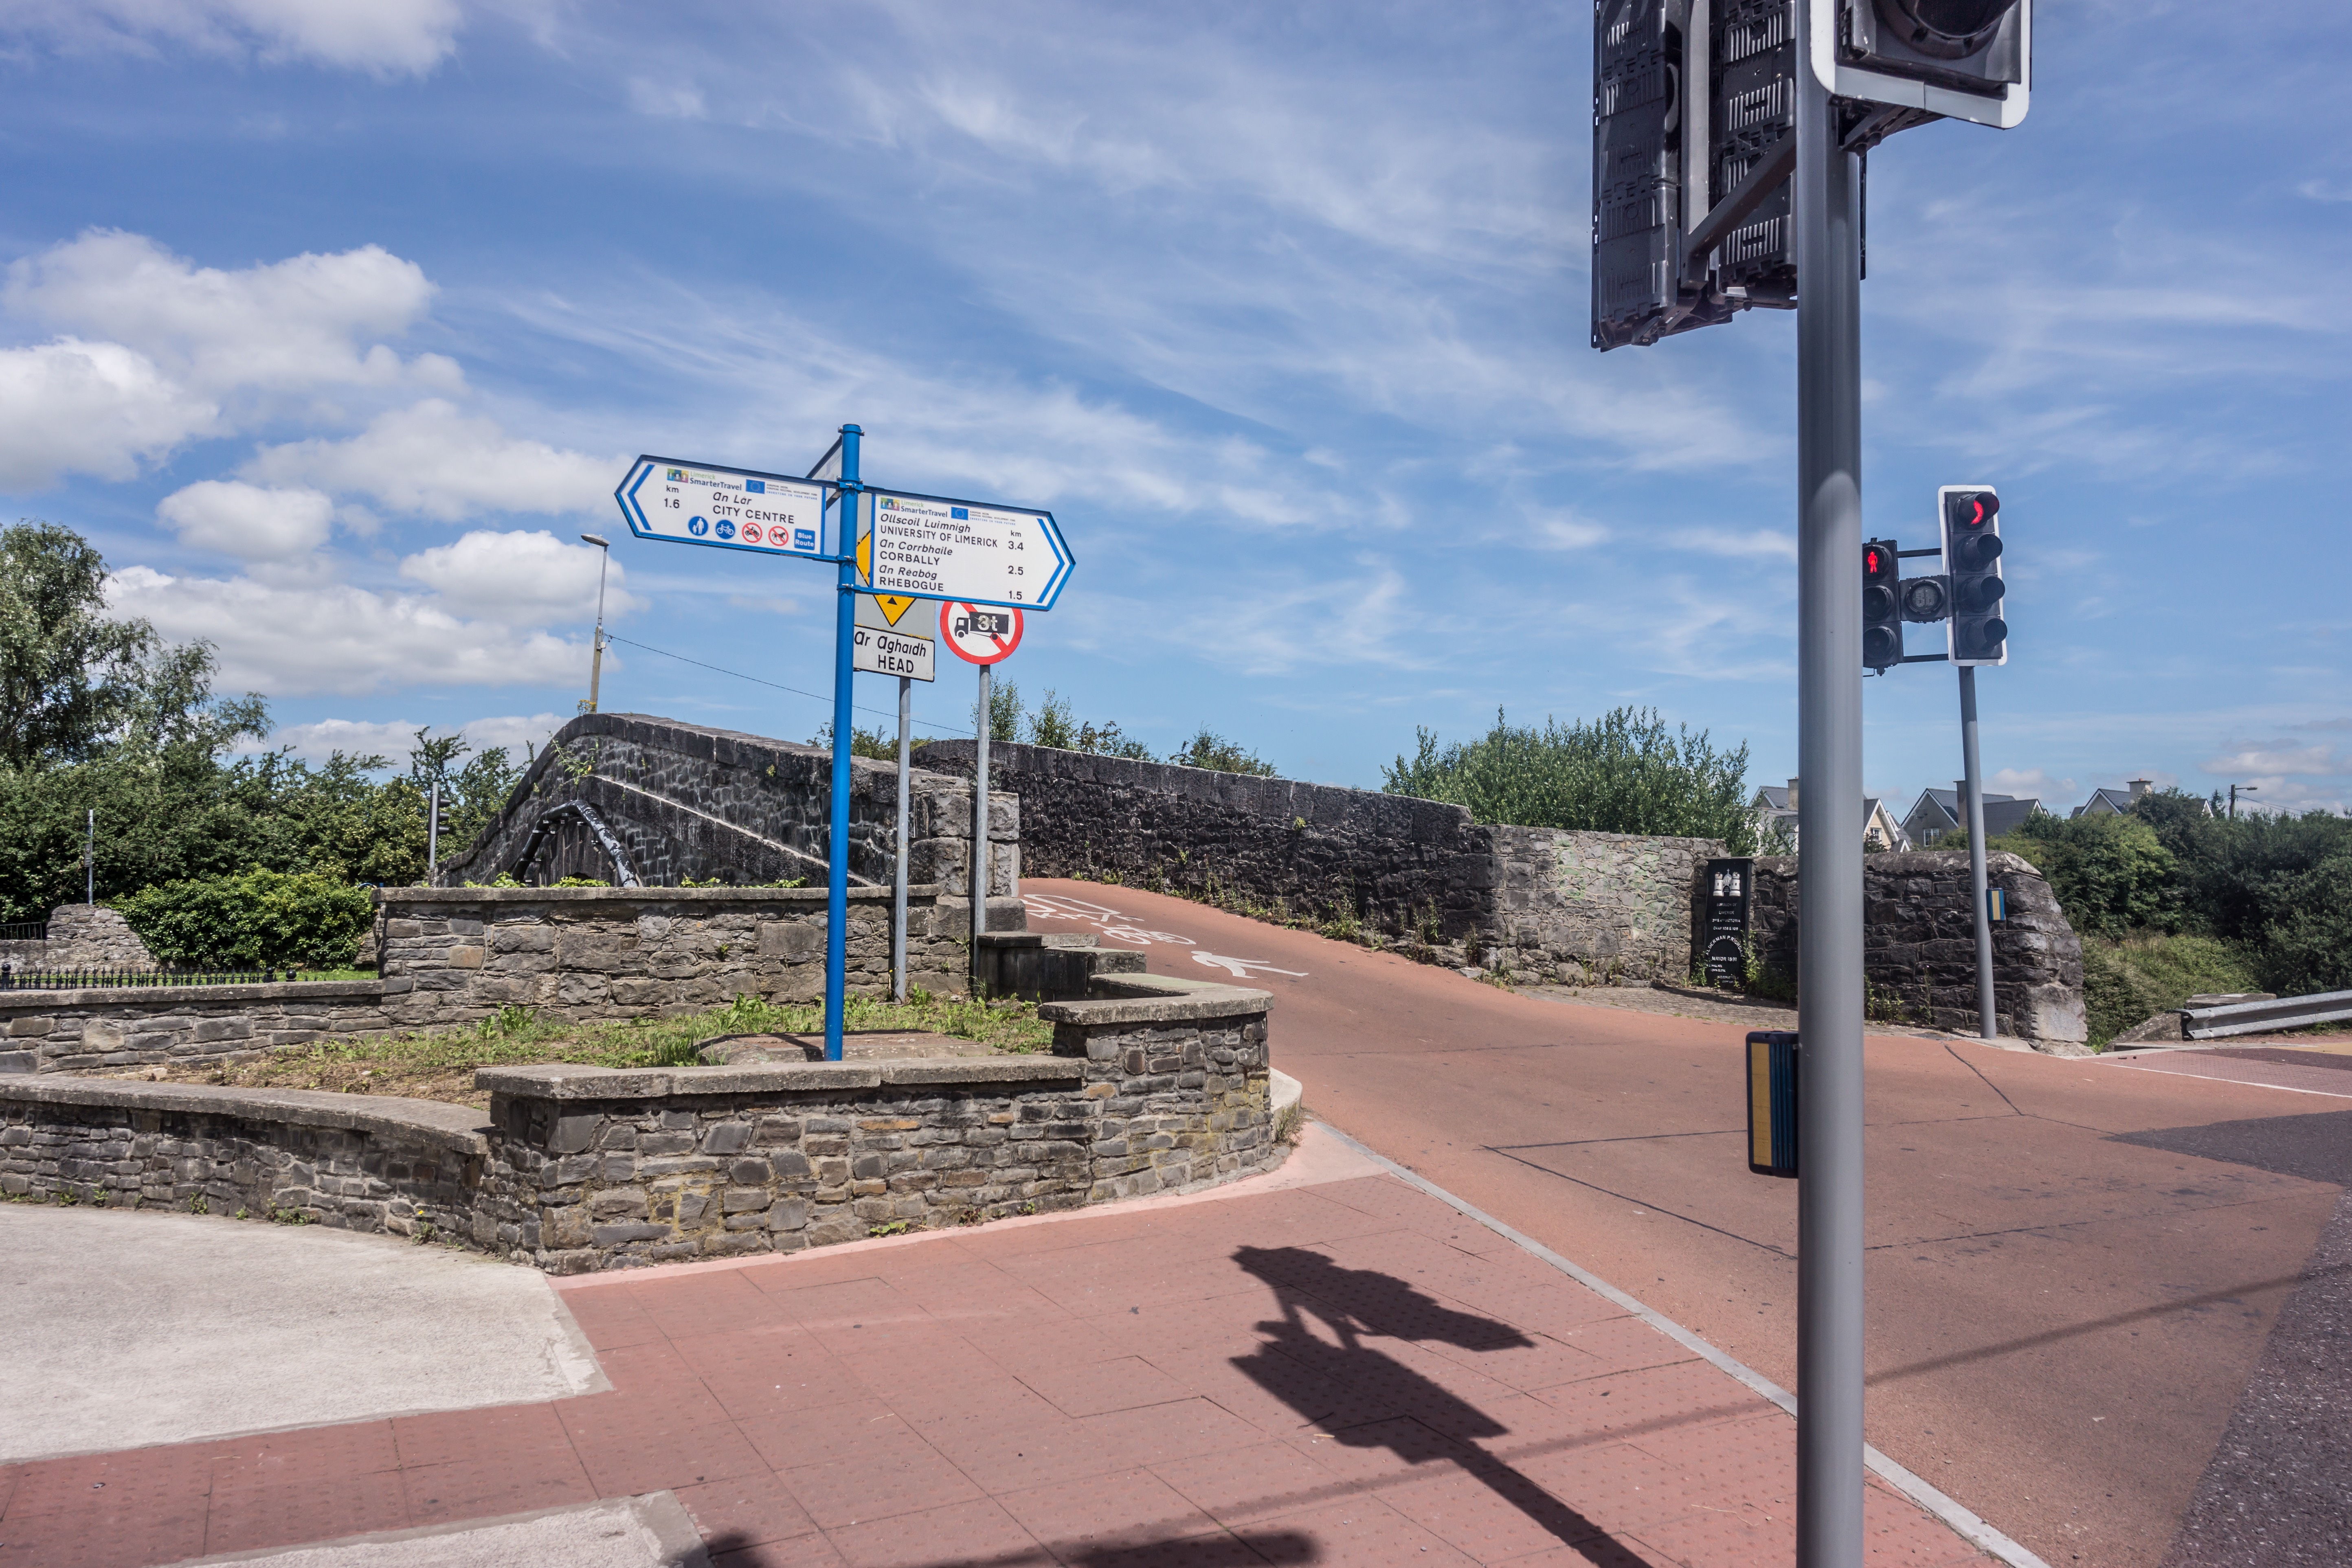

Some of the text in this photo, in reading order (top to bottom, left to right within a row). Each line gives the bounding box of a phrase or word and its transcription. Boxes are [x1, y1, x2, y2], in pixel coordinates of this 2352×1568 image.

[690, 471, 716, 480] Limerick
[666, 485, 679, 493] km
[690, 477, 742, 491] SmarterTravel
[664, 498, 680, 509] 1.6
[713, 505, 794, 524] CITY CENTRE
[901, 505, 947, 518] SmarterTravel
[881, 514, 971, 533] Ollscoil Luimnigh
[881, 525, 998, 548] UNIVERSITY OF LIMERICK
[898, 542, 953, 556] Corrbhaile
[1008, 541, 1023, 551] 3.4
[880, 551, 940, 566] CORBALLY
[898, 567, 937, 580] Réabóg
[1008, 566, 1023, 575] 2.5
[880, 577, 944, 591] RHEBOGUE
[1009, 591, 1022, 600] 1.5
[878, 654, 914, 673] HEAD
[1706, 935, 1726, 955] ALDERMAN
